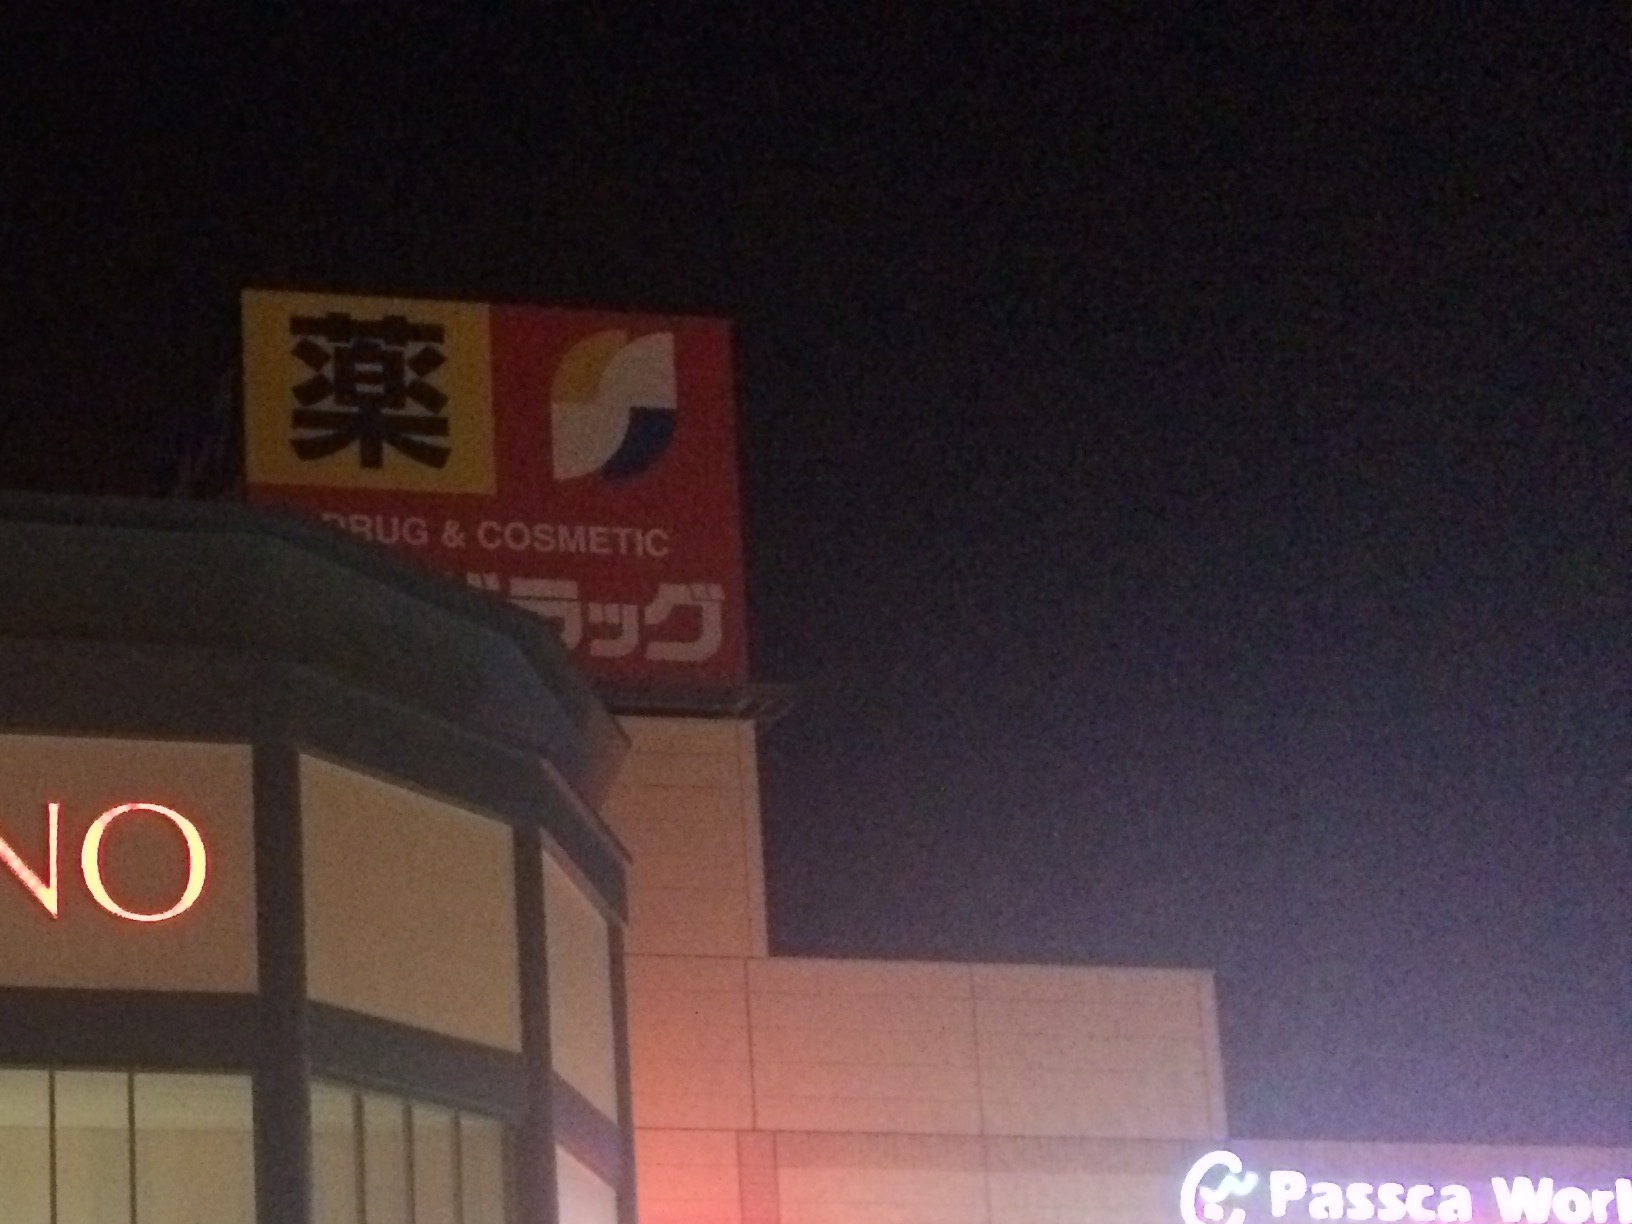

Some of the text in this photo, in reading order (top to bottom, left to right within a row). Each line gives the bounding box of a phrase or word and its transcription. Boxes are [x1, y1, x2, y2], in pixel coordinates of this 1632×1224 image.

[289, 312, 452, 469] 薬
[441, 520, 466, 548] &
[477, 520, 669, 557] COSMETIC
[466, 572, 725, 662] ラッグ
[1270, 1170, 1474, 1222] Passca
